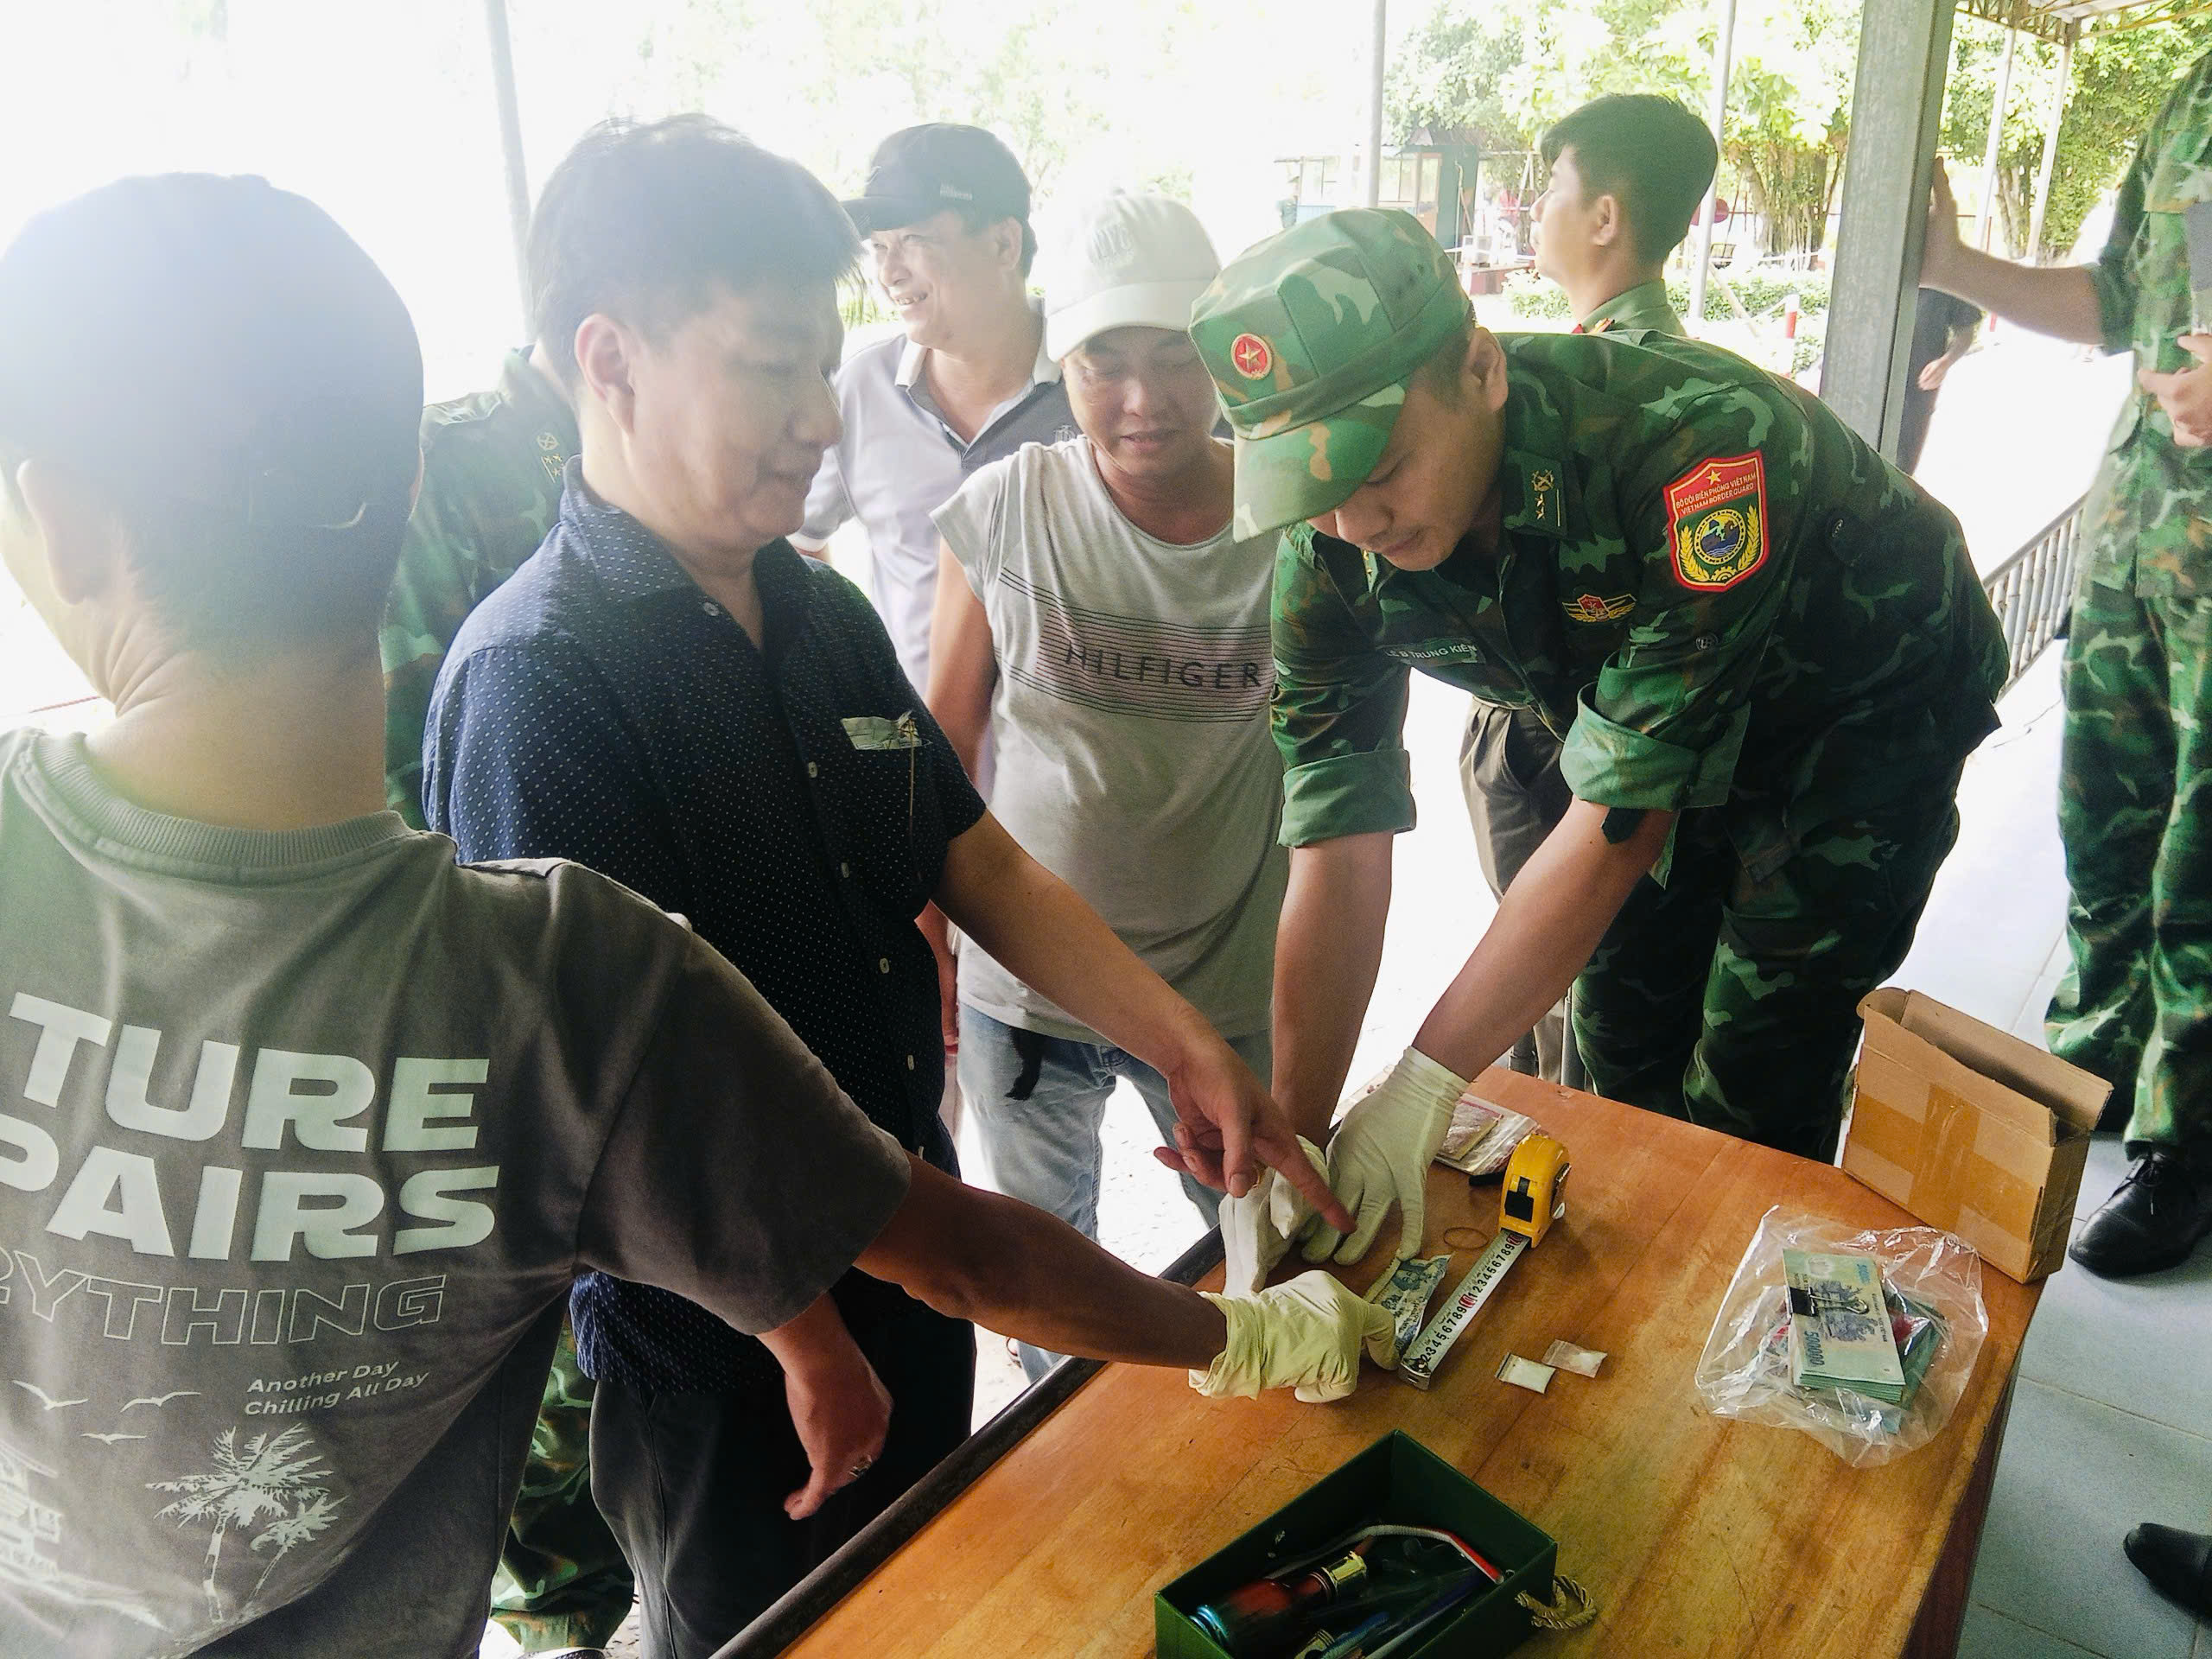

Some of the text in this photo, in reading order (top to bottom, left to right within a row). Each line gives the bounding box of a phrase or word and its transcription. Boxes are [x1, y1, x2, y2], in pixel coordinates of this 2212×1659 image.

[1694, 499, 1708, 509] NAM
[1709, 490, 1733, 505] BORDER
[1733, 482, 1754, 495] GUARD
[1065, 640, 1262, 689] HILFIGER
[1409, 648, 1448, 658] TRUNG
[1449, 644, 1478, 653] KIÊN
[9, 991, 490, 1153] TURE
[0, 1246, 447, 1345] YTHING
[245, 1372, 429, 1414] Chilling All Day
[247, 1361, 399, 1393] Another Day
